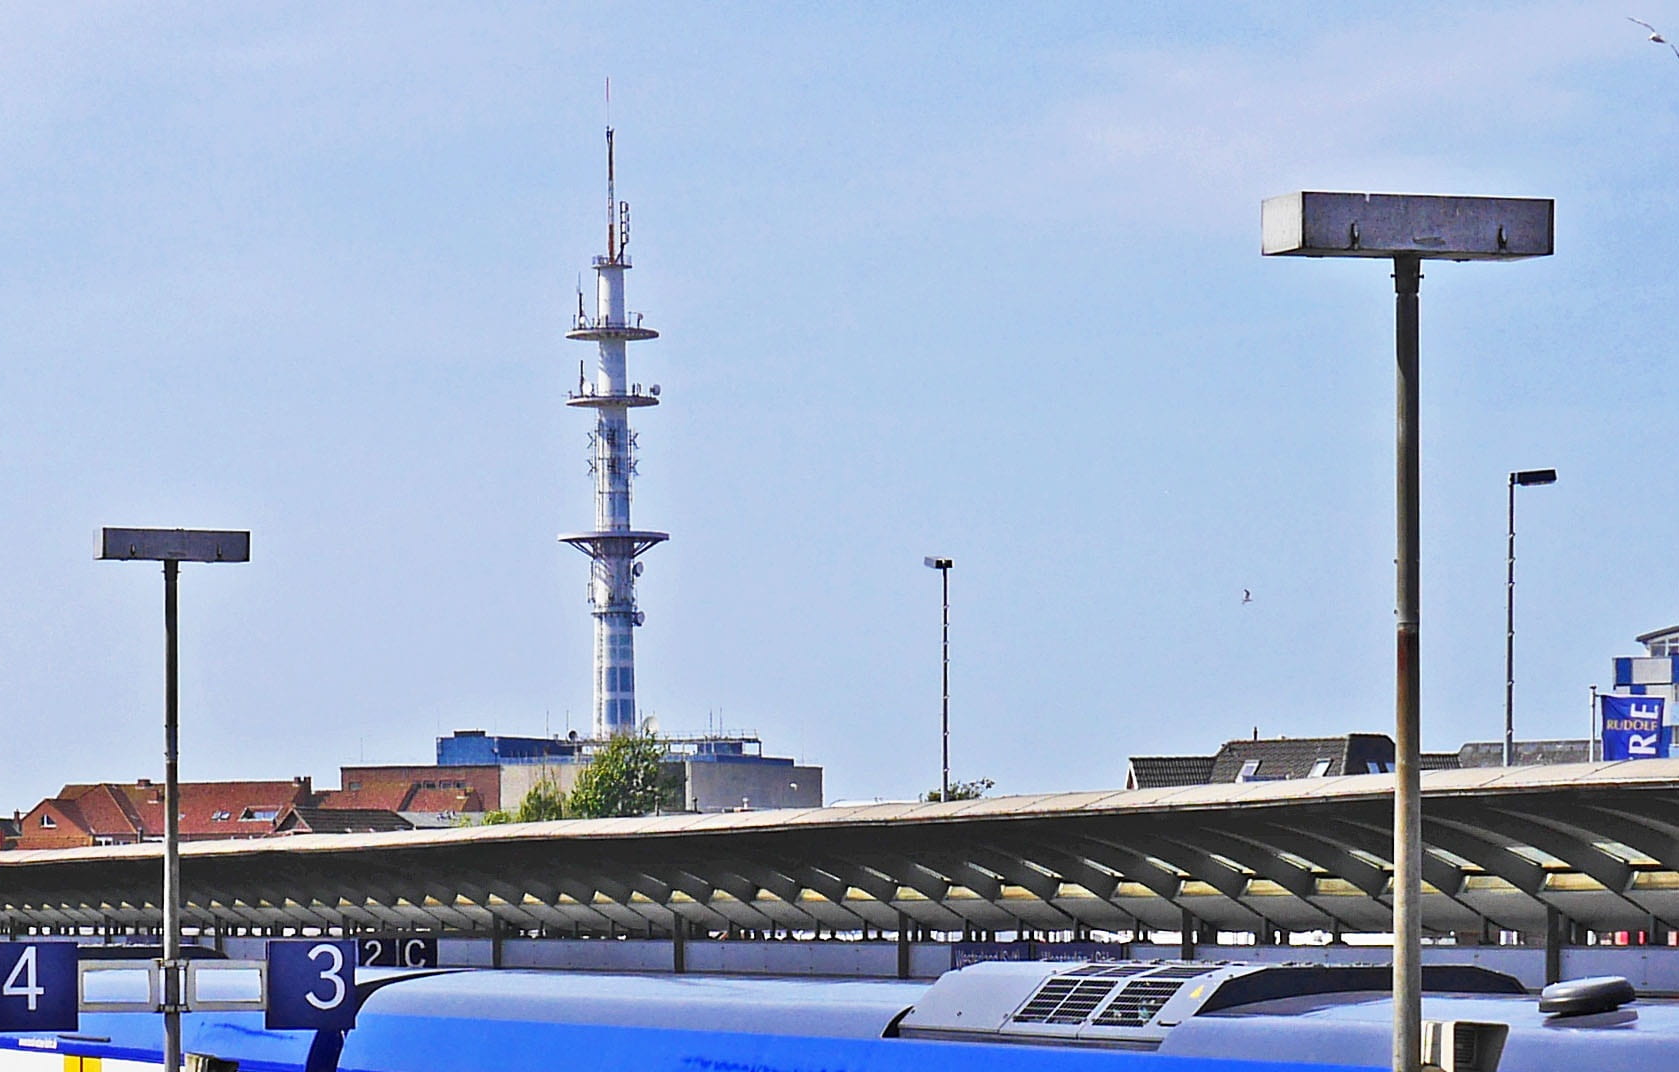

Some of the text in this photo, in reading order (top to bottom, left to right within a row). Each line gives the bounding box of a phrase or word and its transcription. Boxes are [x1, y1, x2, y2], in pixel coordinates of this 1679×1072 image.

[1606, 719, 1658, 731] RUDOLF
[364, 939, 382, 967] 2
[404, 939, 427, 967] C
[2, 946, 44, 1011] 4
[304, 945, 346, 1010] 3
